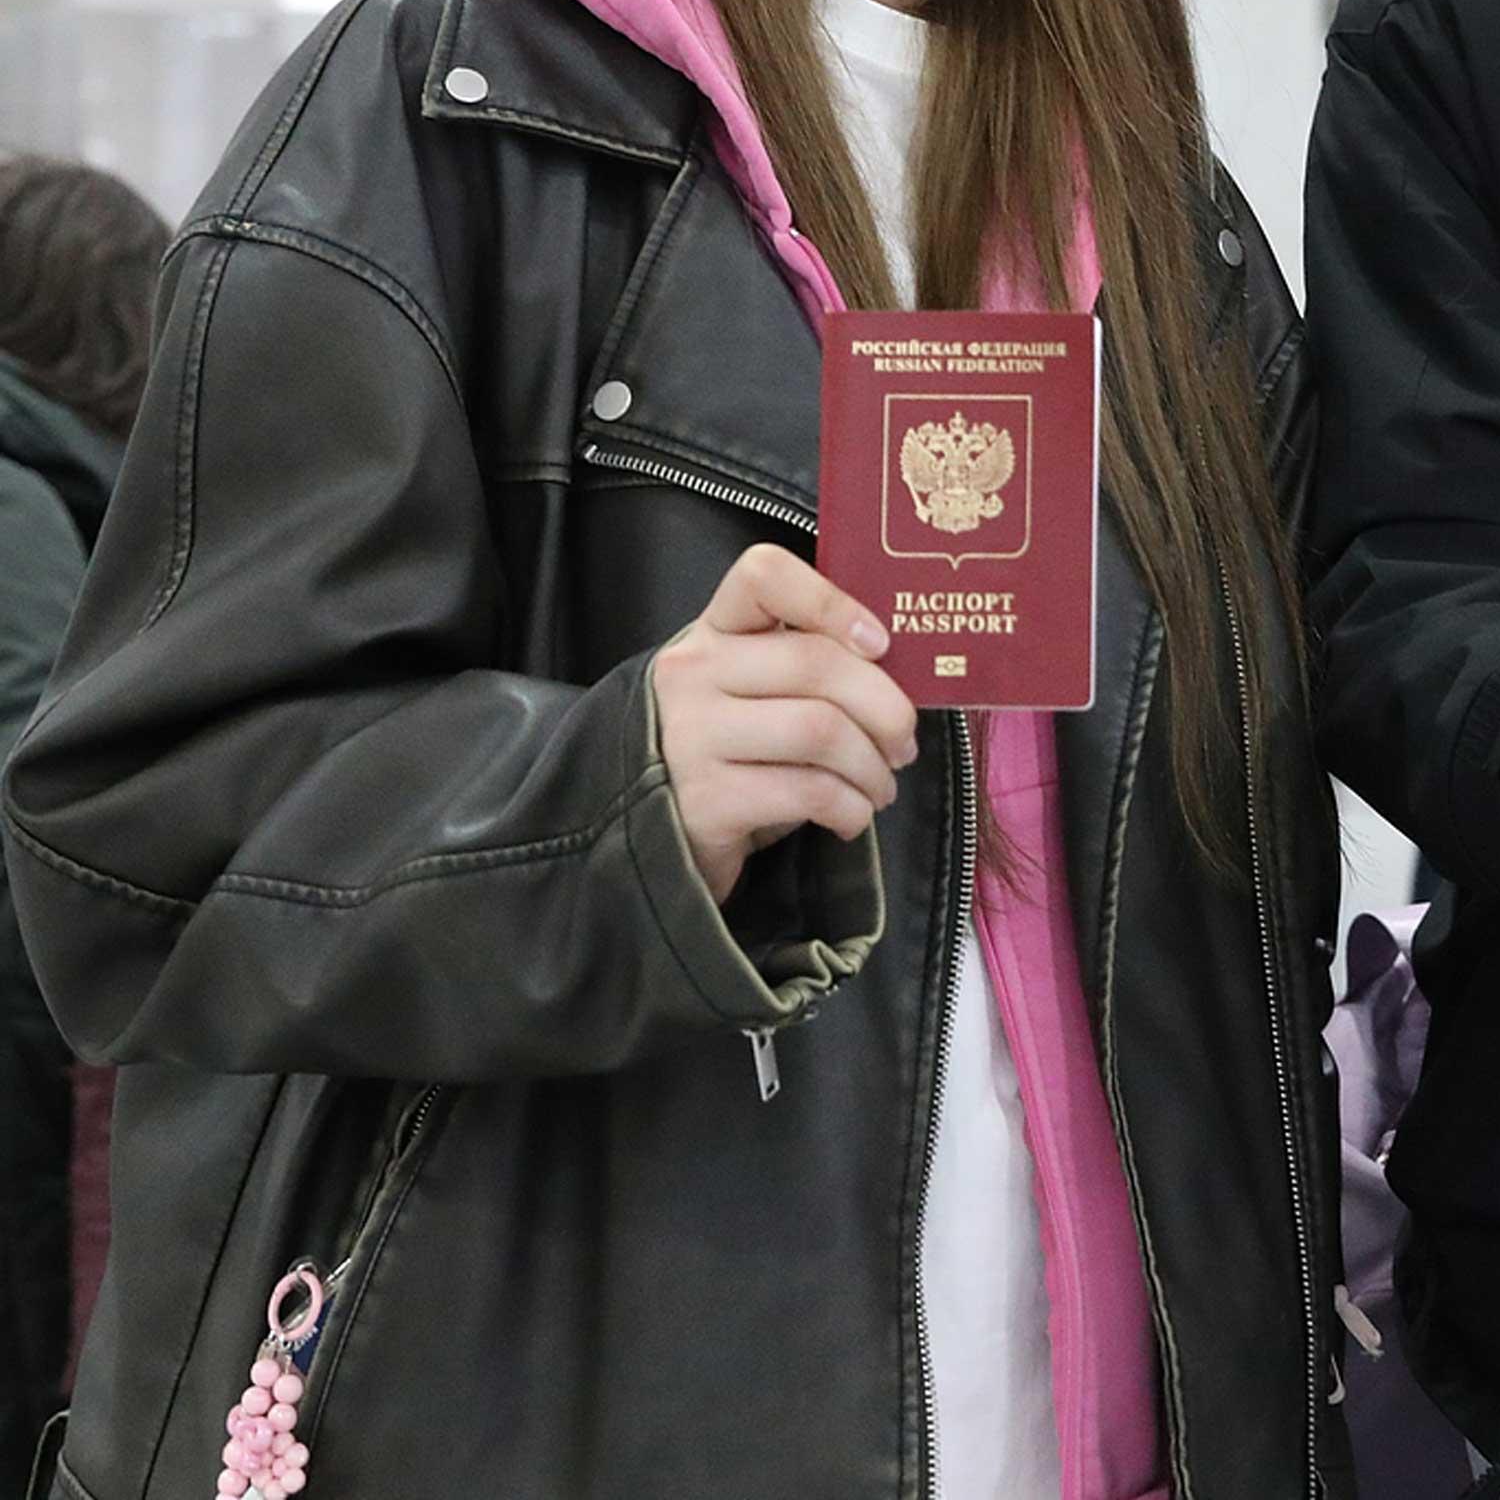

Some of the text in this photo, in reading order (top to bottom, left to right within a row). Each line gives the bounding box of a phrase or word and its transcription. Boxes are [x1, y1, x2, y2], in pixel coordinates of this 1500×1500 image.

[852, 339, 1067, 357] РОССИЙСКАЯ ФЕДЕРАЦИЯ
[873, 357, 1044, 373] RUSSIAN FEDERATION
[894, 591, 1015, 612] ПАСПОРТ
[891, 613, 1018, 635] PASSPORT
